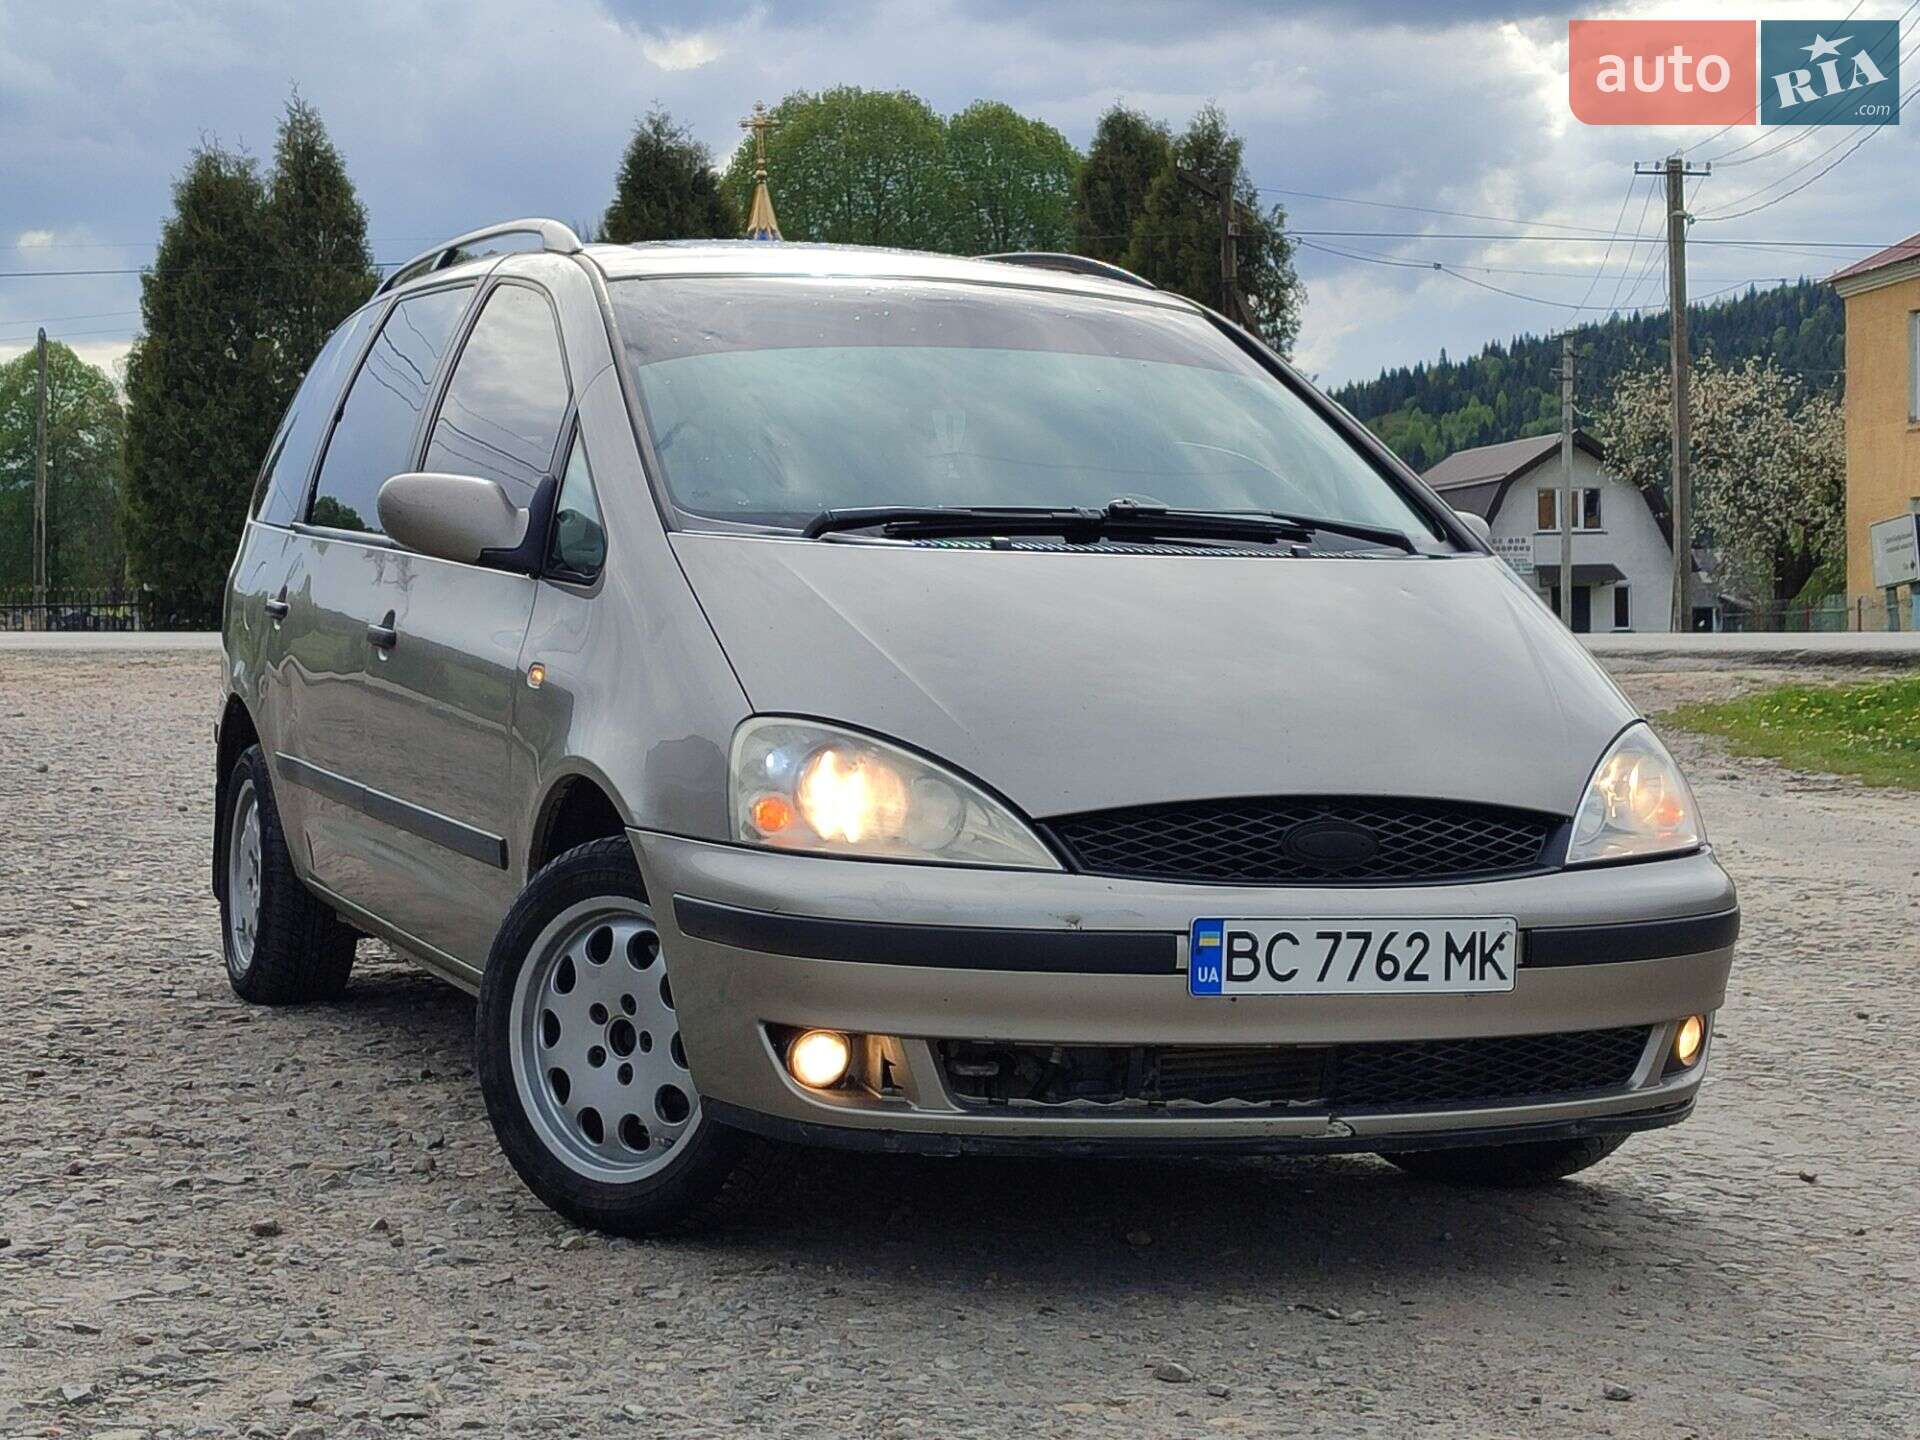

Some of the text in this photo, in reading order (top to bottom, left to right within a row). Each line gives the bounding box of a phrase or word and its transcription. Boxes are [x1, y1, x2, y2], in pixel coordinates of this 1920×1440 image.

[1199, 965, 1219, 983] UA
[1226, 930, 1509, 983] BC 7762 MK
